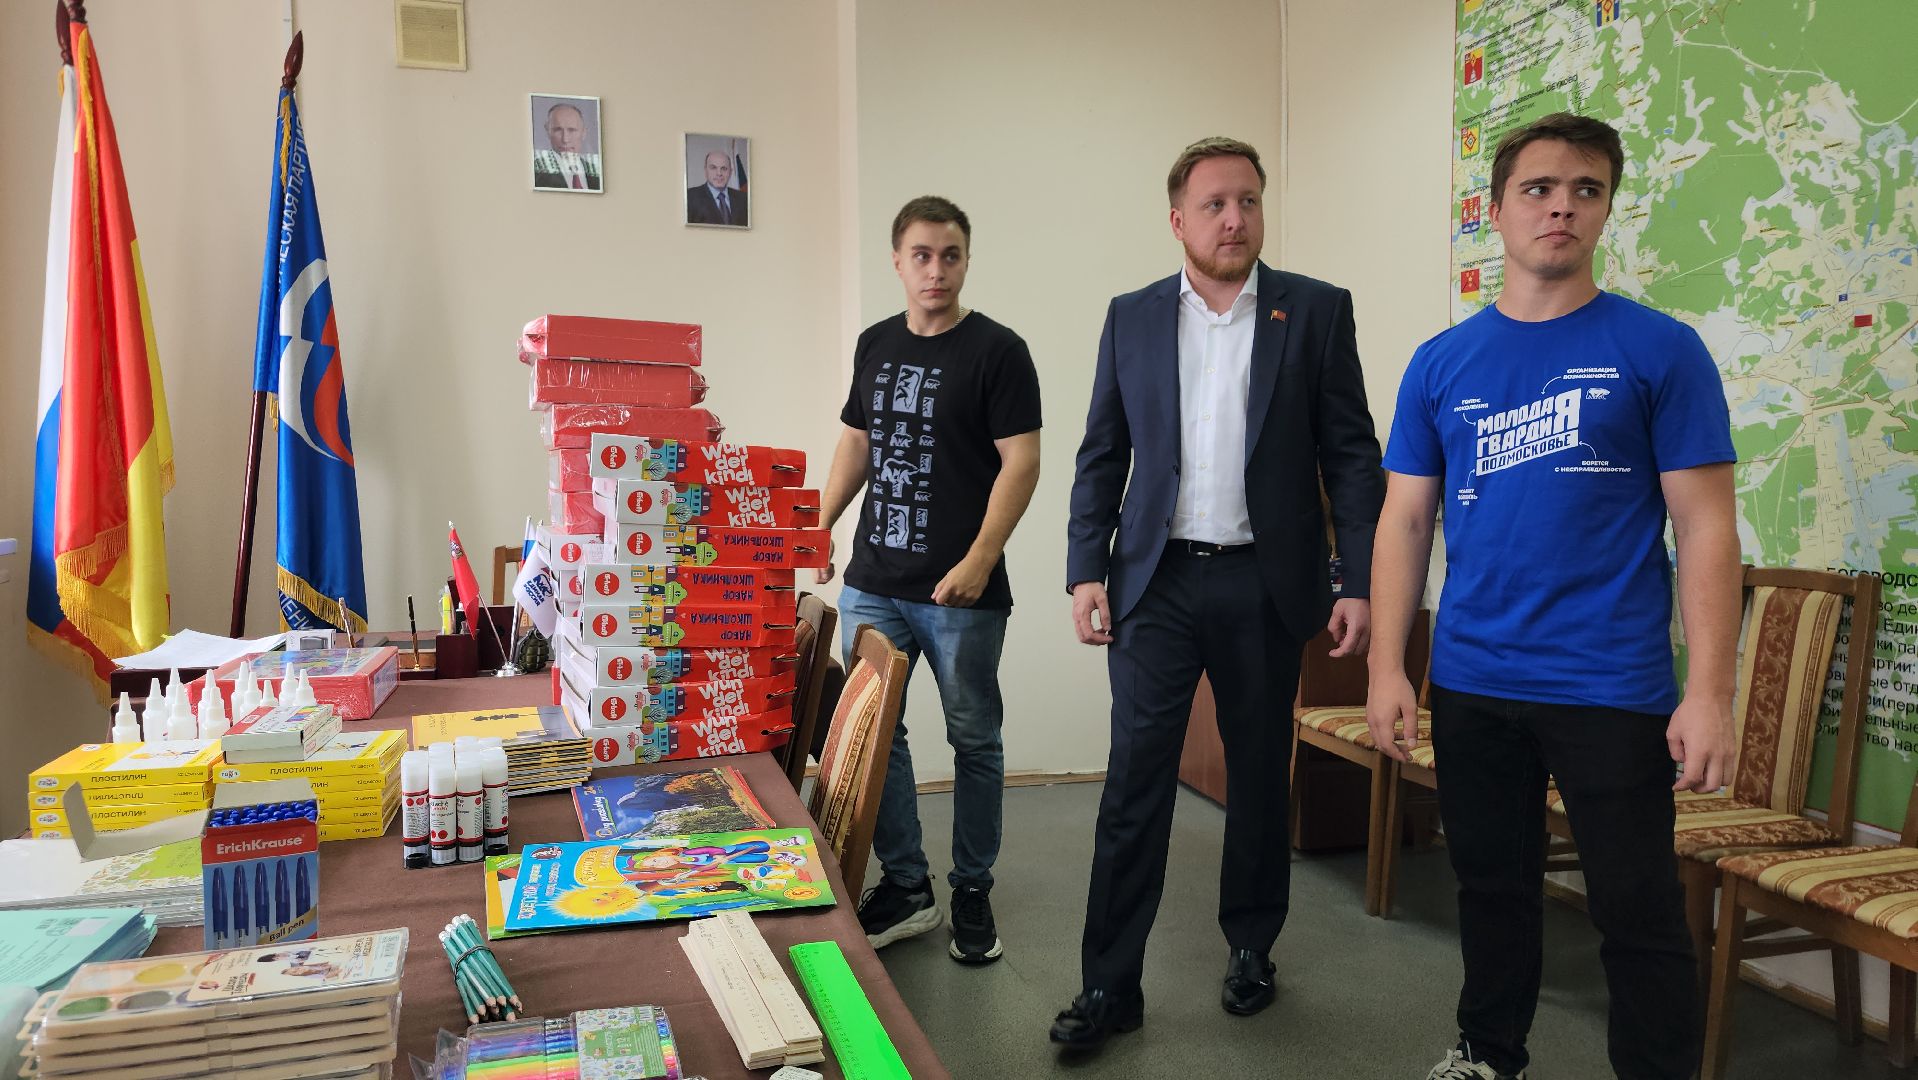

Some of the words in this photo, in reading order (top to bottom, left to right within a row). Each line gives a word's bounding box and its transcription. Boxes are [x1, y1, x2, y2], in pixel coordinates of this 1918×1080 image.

[1562, 372, 1620, 380] ВОЗМОЖНОСТЕЙ
[1477, 388, 1581, 436] МОЛОДАЯ
[1477, 402, 1581, 457] ГВАРДИЯ
[701, 443, 748, 461] Wun
[1481, 432, 1571, 472] ПОДМОСКОВЬЕ
[715, 453, 749, 470] der
[704, 469, 755, 486] kind!
[725, 486, 769, 504] Wun
[738, 495, 771, 512] der
[728, 511, 776, 527] kind!
[723, 534, 784, 546] ШКОЛЬНИКА
[752, 551, 784, 562] НАБОР
[692, 573, 754, 585] ШКОЛЬНИКА
[722, 588, 754, 600] НАБОР
[690, 613, 753, 625] ШКОЛЬНИКА
[720, 630, 752, 641] НАБОР
[718, 651, 751, 670] der
[707, 665, 755, 682] kind!
[698, 678, 743, 700] Wun
[712, 690, 744, 708] der
[703, 703, 750, 719] kind!
[691, 715, 738, 738] Wun
[706, 728, 739, 746] der
[696, 739, 748, 757] kind!
[91, 773, 147, 784] ПЛАСТИЛИН
[270, 765, 323, 775] ПЛАСТИЛИН
[216, 836, 303, 855] ErichKrause
[269, 928, 286, 942] Ball
[287, 918, 305, 933] pen
